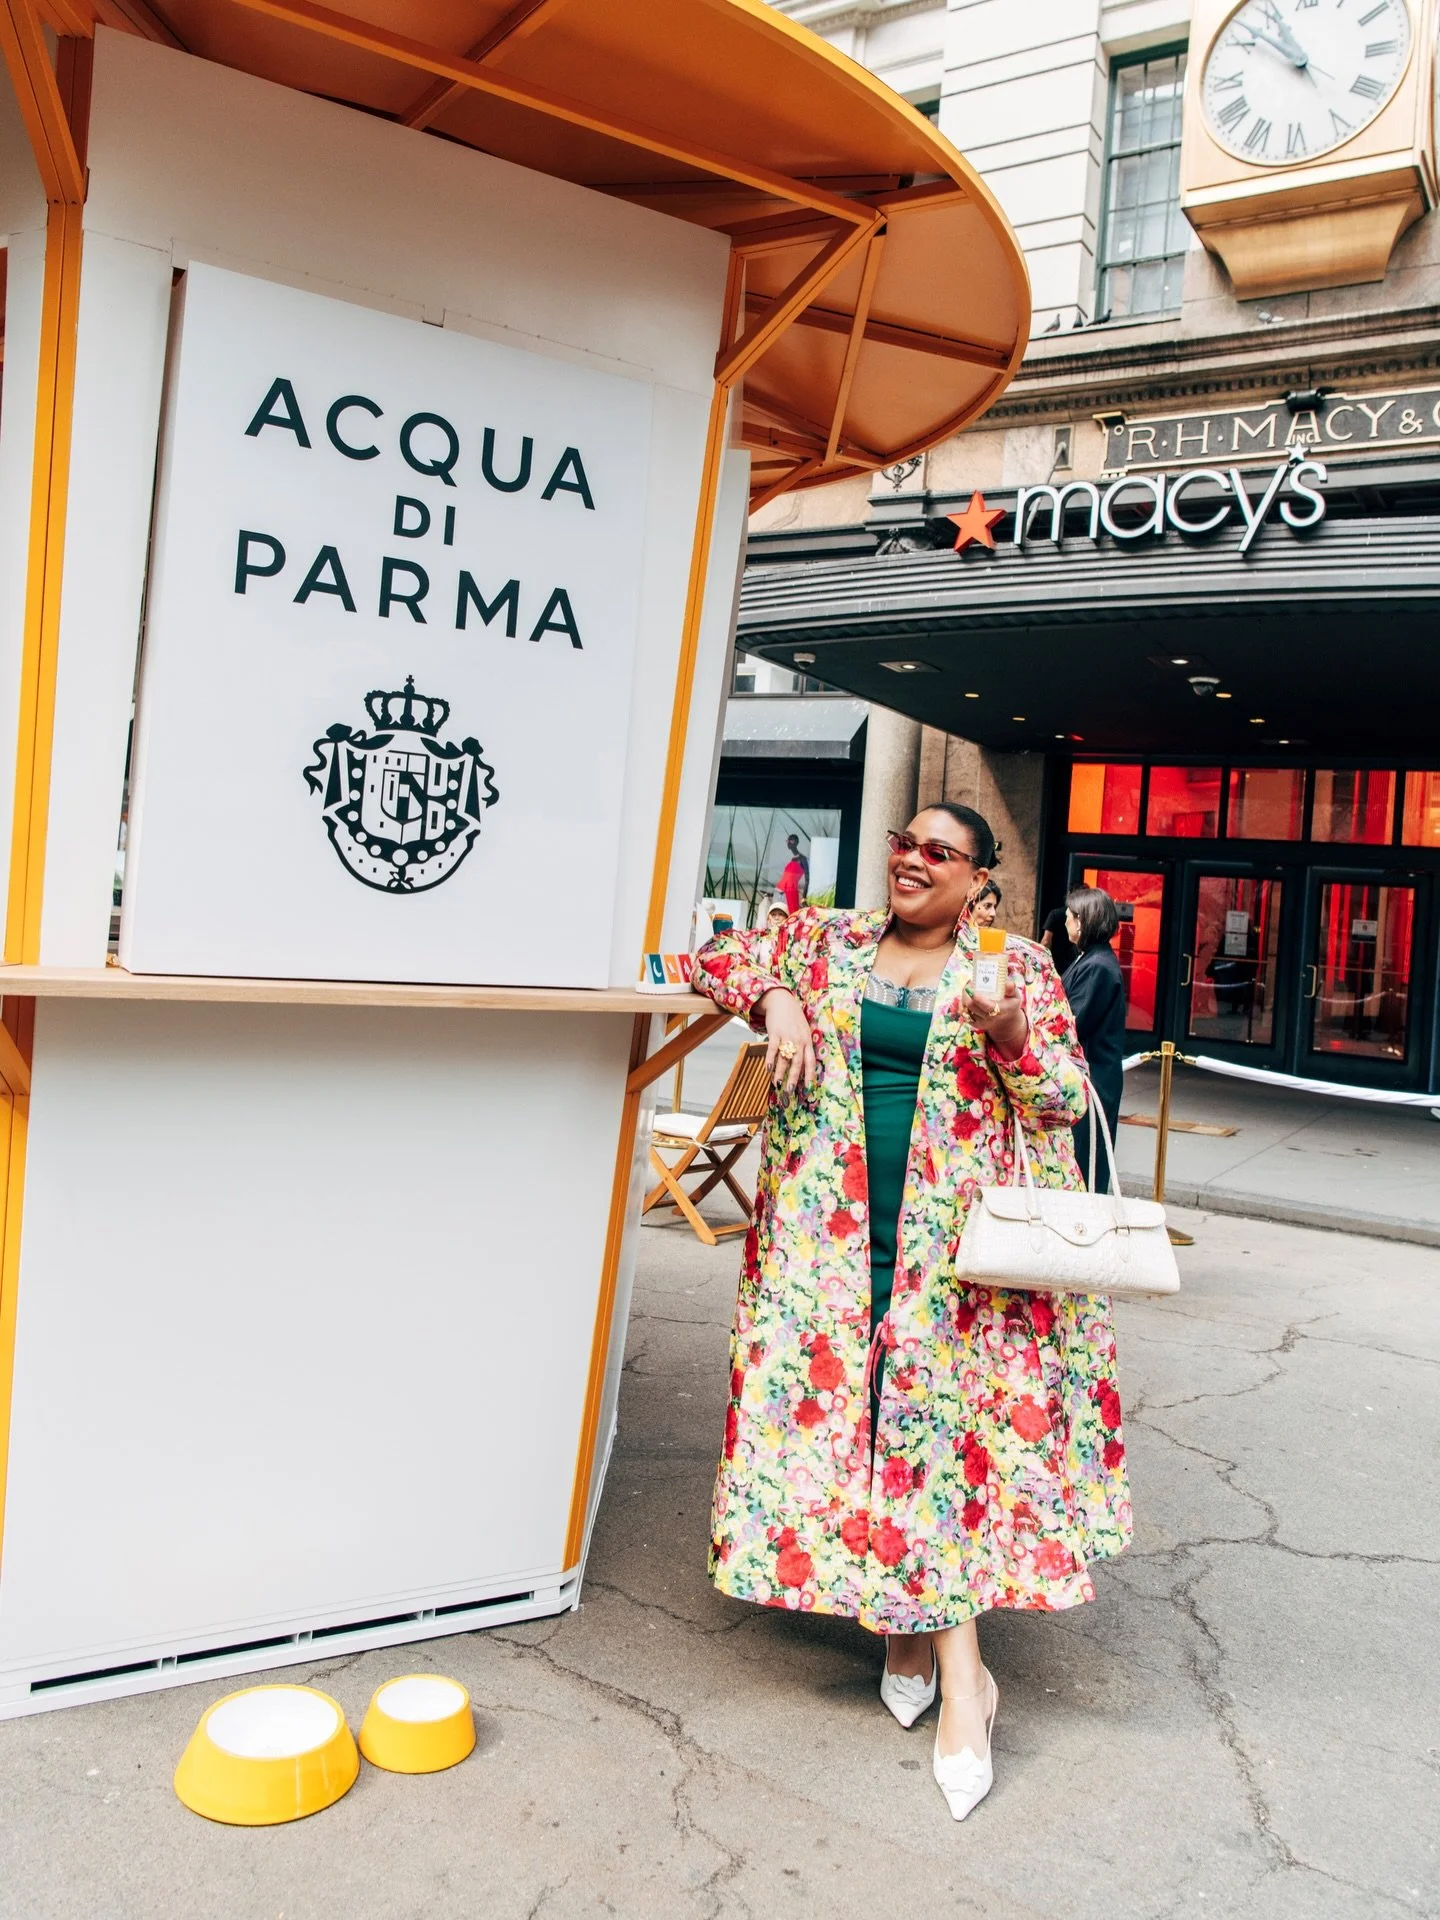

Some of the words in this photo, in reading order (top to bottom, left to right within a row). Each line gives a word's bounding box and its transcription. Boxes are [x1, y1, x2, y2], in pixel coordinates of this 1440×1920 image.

[244, 377, 596, 511] ACQUA
[393, 494, 457, 546] DI
[234, 529, 584, 650] PARMA
